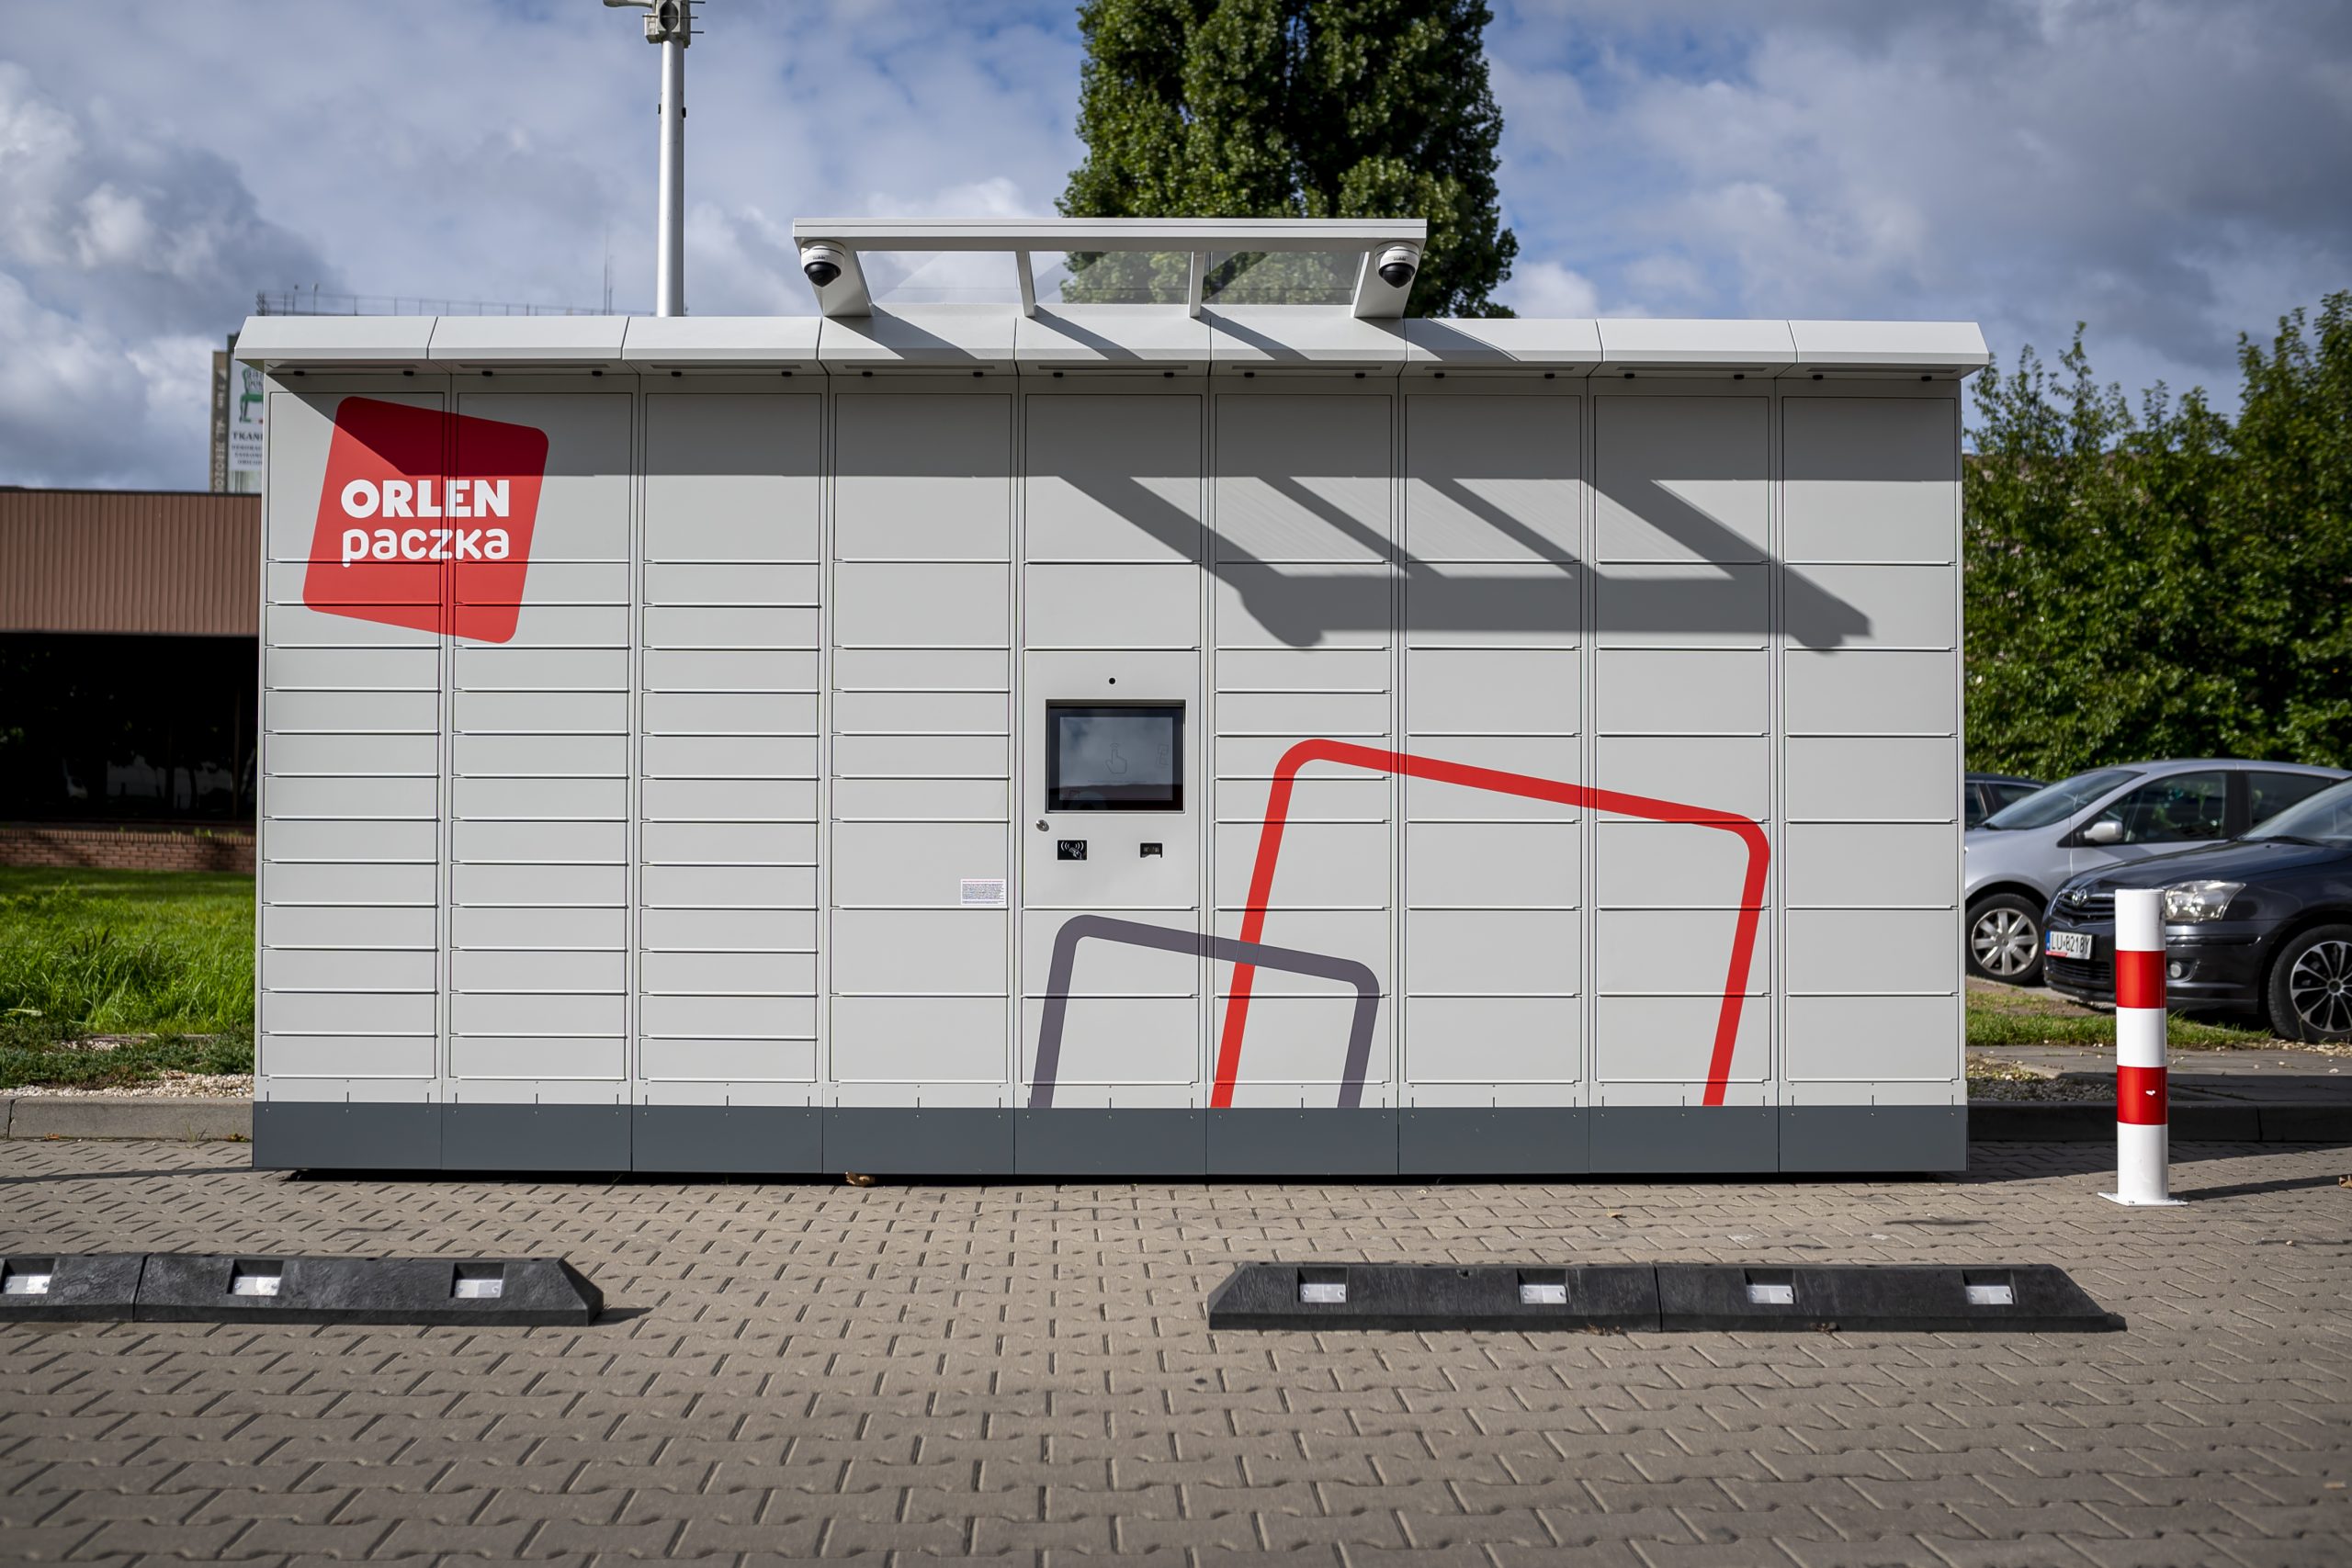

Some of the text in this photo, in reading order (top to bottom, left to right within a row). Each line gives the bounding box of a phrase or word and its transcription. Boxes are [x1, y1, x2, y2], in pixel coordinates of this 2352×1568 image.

[341, 479, 510, 519] ORLEN
[342, 528, 510, 568] paczka
[2052, 932, 2064, 951] LU
